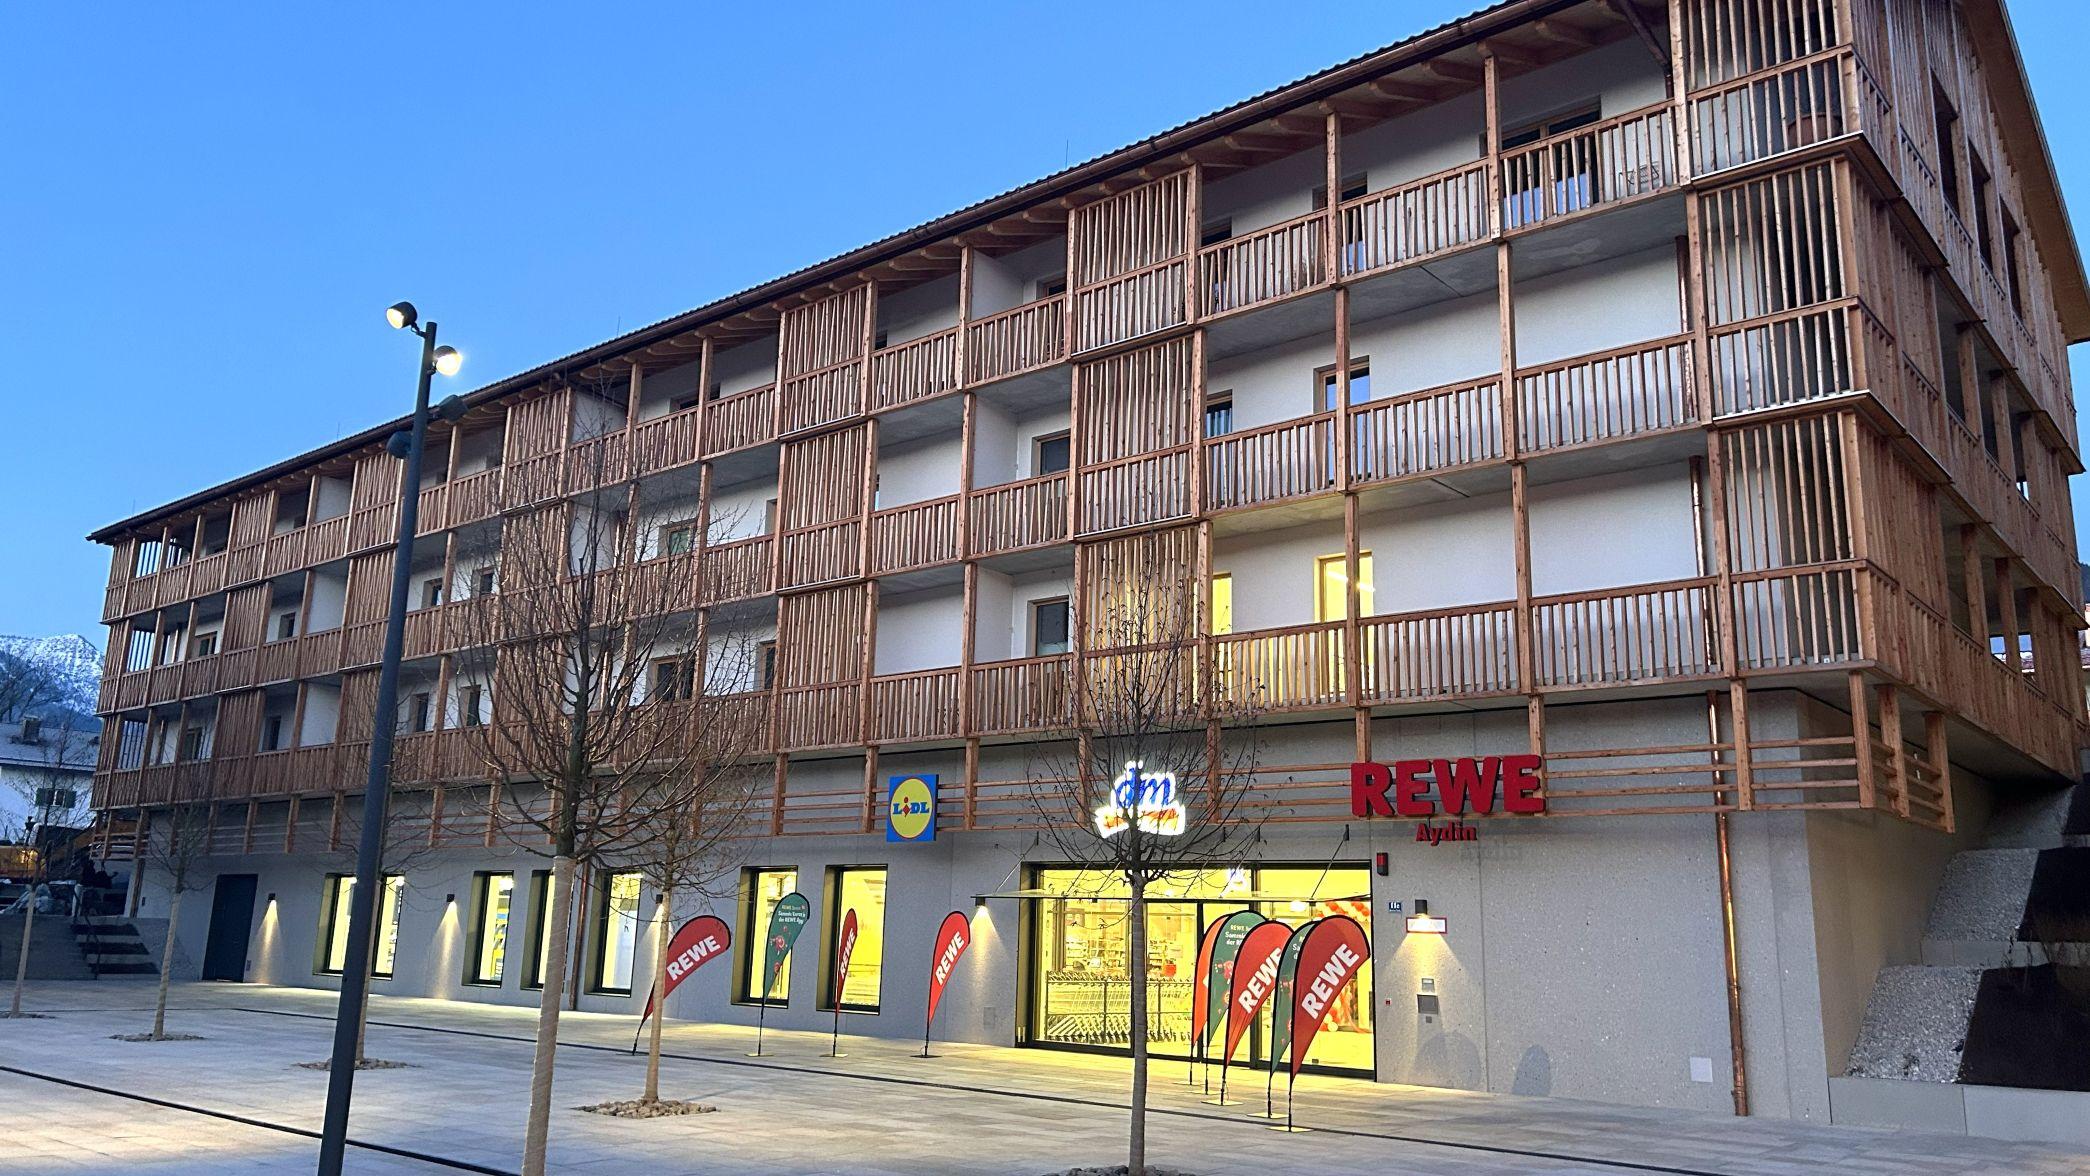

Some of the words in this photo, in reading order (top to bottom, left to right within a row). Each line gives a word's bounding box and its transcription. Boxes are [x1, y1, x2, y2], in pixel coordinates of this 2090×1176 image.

[1114, 765, 1172, 808] dm
[1350, 754, 1546, 817] REWE
[666, 935, 721, 981] REWE
[840, 927, 855, 979] REWE
[935, 931, 965, 985] REWE
[1301, 943, 1360, 1019] REWE
